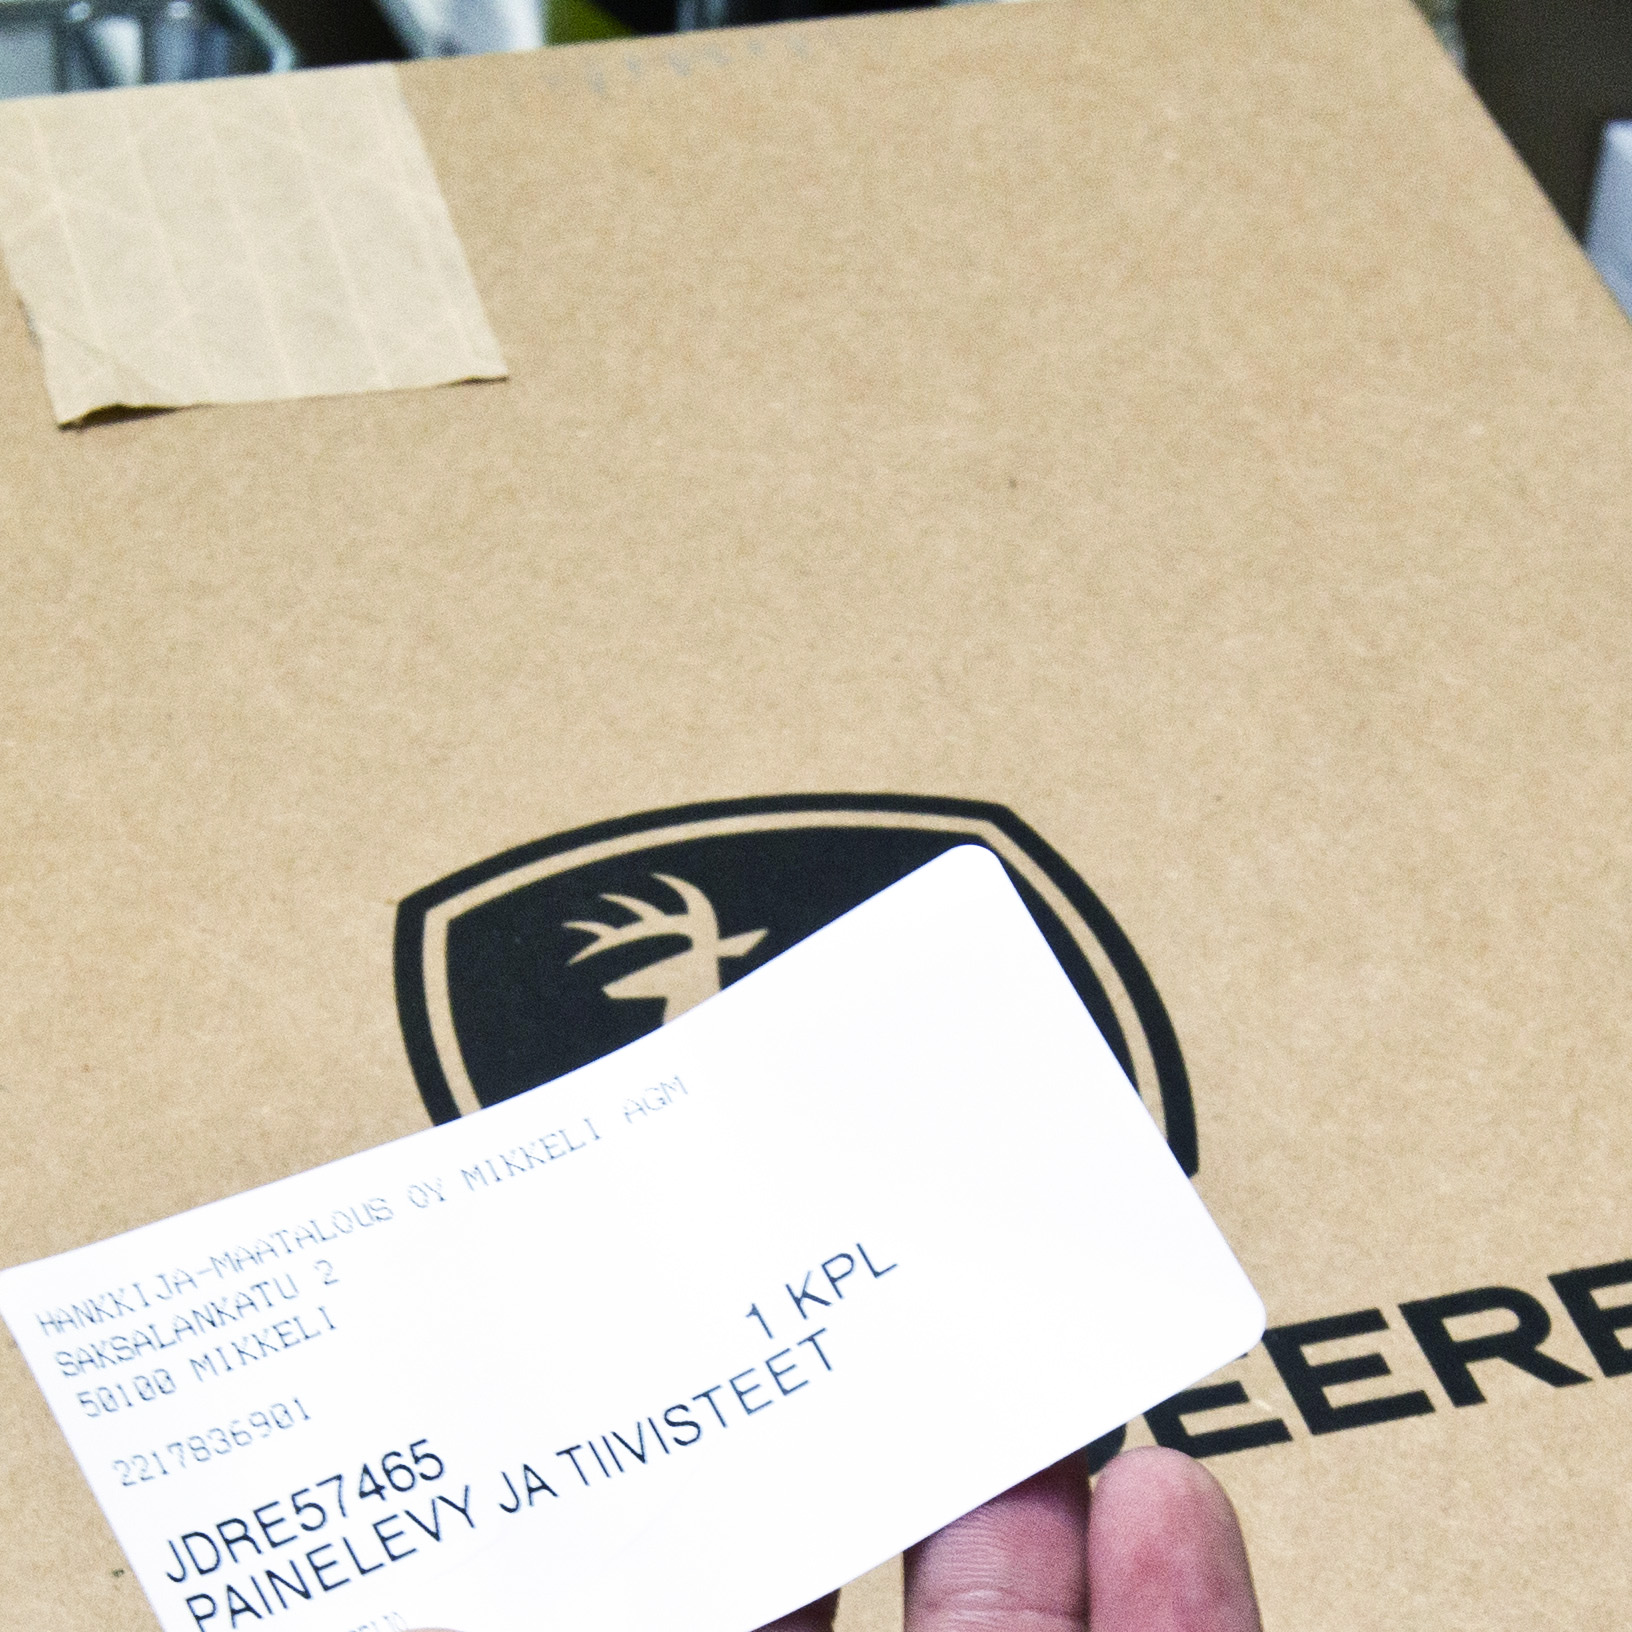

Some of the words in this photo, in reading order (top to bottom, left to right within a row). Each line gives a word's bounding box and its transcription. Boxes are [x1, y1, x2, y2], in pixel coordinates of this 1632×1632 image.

[35, 1197, 394, 1336] HANKKIJA-MAATALOUS
[407, 1178, 447, 1209] OY
[460, 1117, 602, 1191] MIKKELI
[622, 1075, 689, 1124] AGM
[54, 1273, 301, 1377] SAKSALANKATU
[314, 1259, 339, 1285] 2
[746, 1303, 772, 1338] 1
[786, 1243, 897, 1319] KPL
[77, 1369, 176, 1417] 50100
[189, 1305, 338, 1384] MIKKELI
[112, 1398, 312, 1487] 2217836901
[500, 1464, 558, 1513] JA
[556, 1328, 832, 1486] TIIVISTEET
[166, 1439, 445, 1583] JDRE57465
